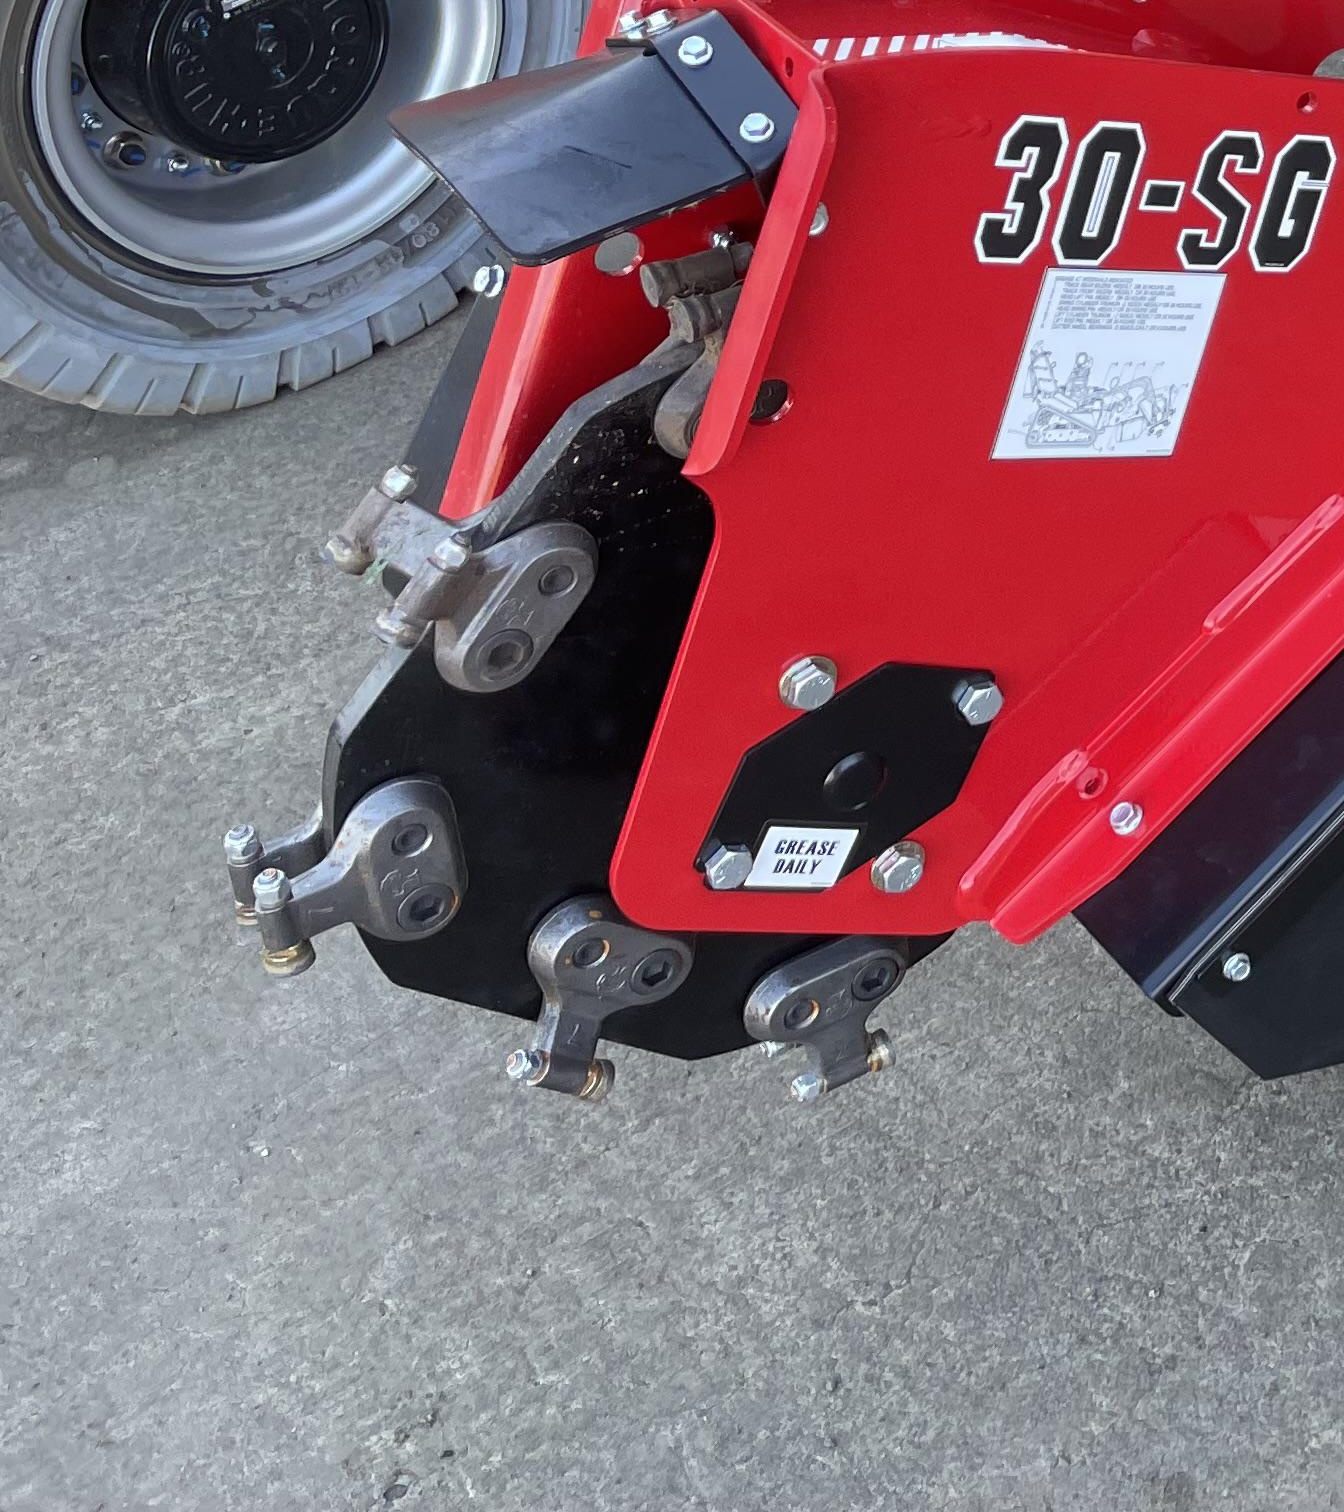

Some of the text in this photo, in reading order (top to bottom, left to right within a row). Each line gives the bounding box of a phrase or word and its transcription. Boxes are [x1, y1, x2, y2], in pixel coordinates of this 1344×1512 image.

[974, 114, 1338, 272] 30-SG
[774, 839, 841, 856] GREASE
[773, 858, 823, 875] DAILY
